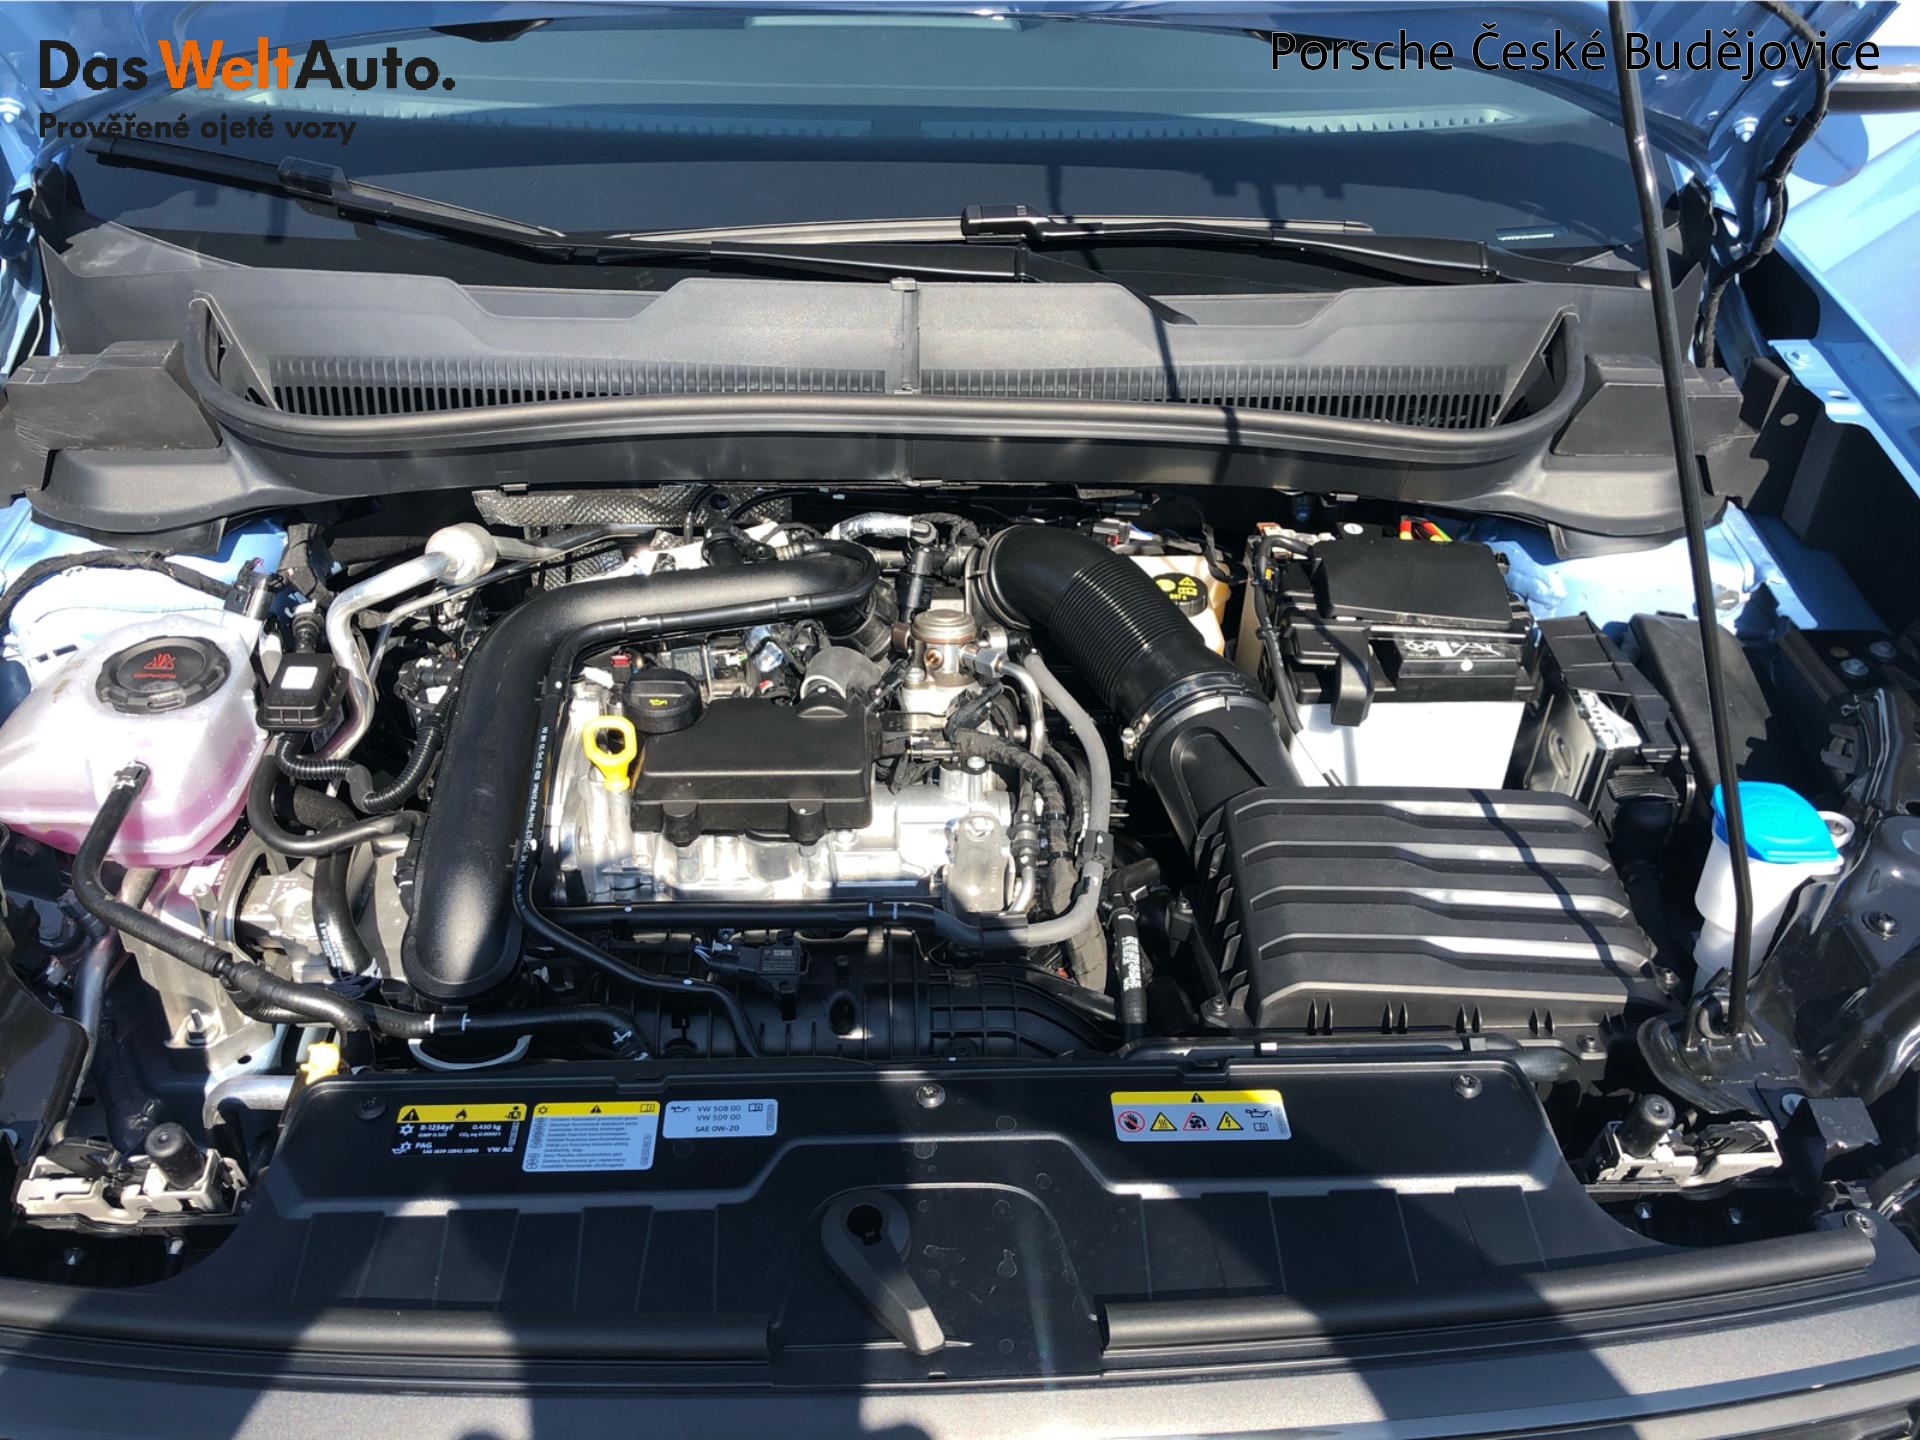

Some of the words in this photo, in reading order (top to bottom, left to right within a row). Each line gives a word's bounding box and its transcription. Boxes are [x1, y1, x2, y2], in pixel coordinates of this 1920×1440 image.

[713, 1104, 729, 1112] 508
[730, 1113, 741, 1121] 00
[420, 1124, 453, 1132] R-1234yf
